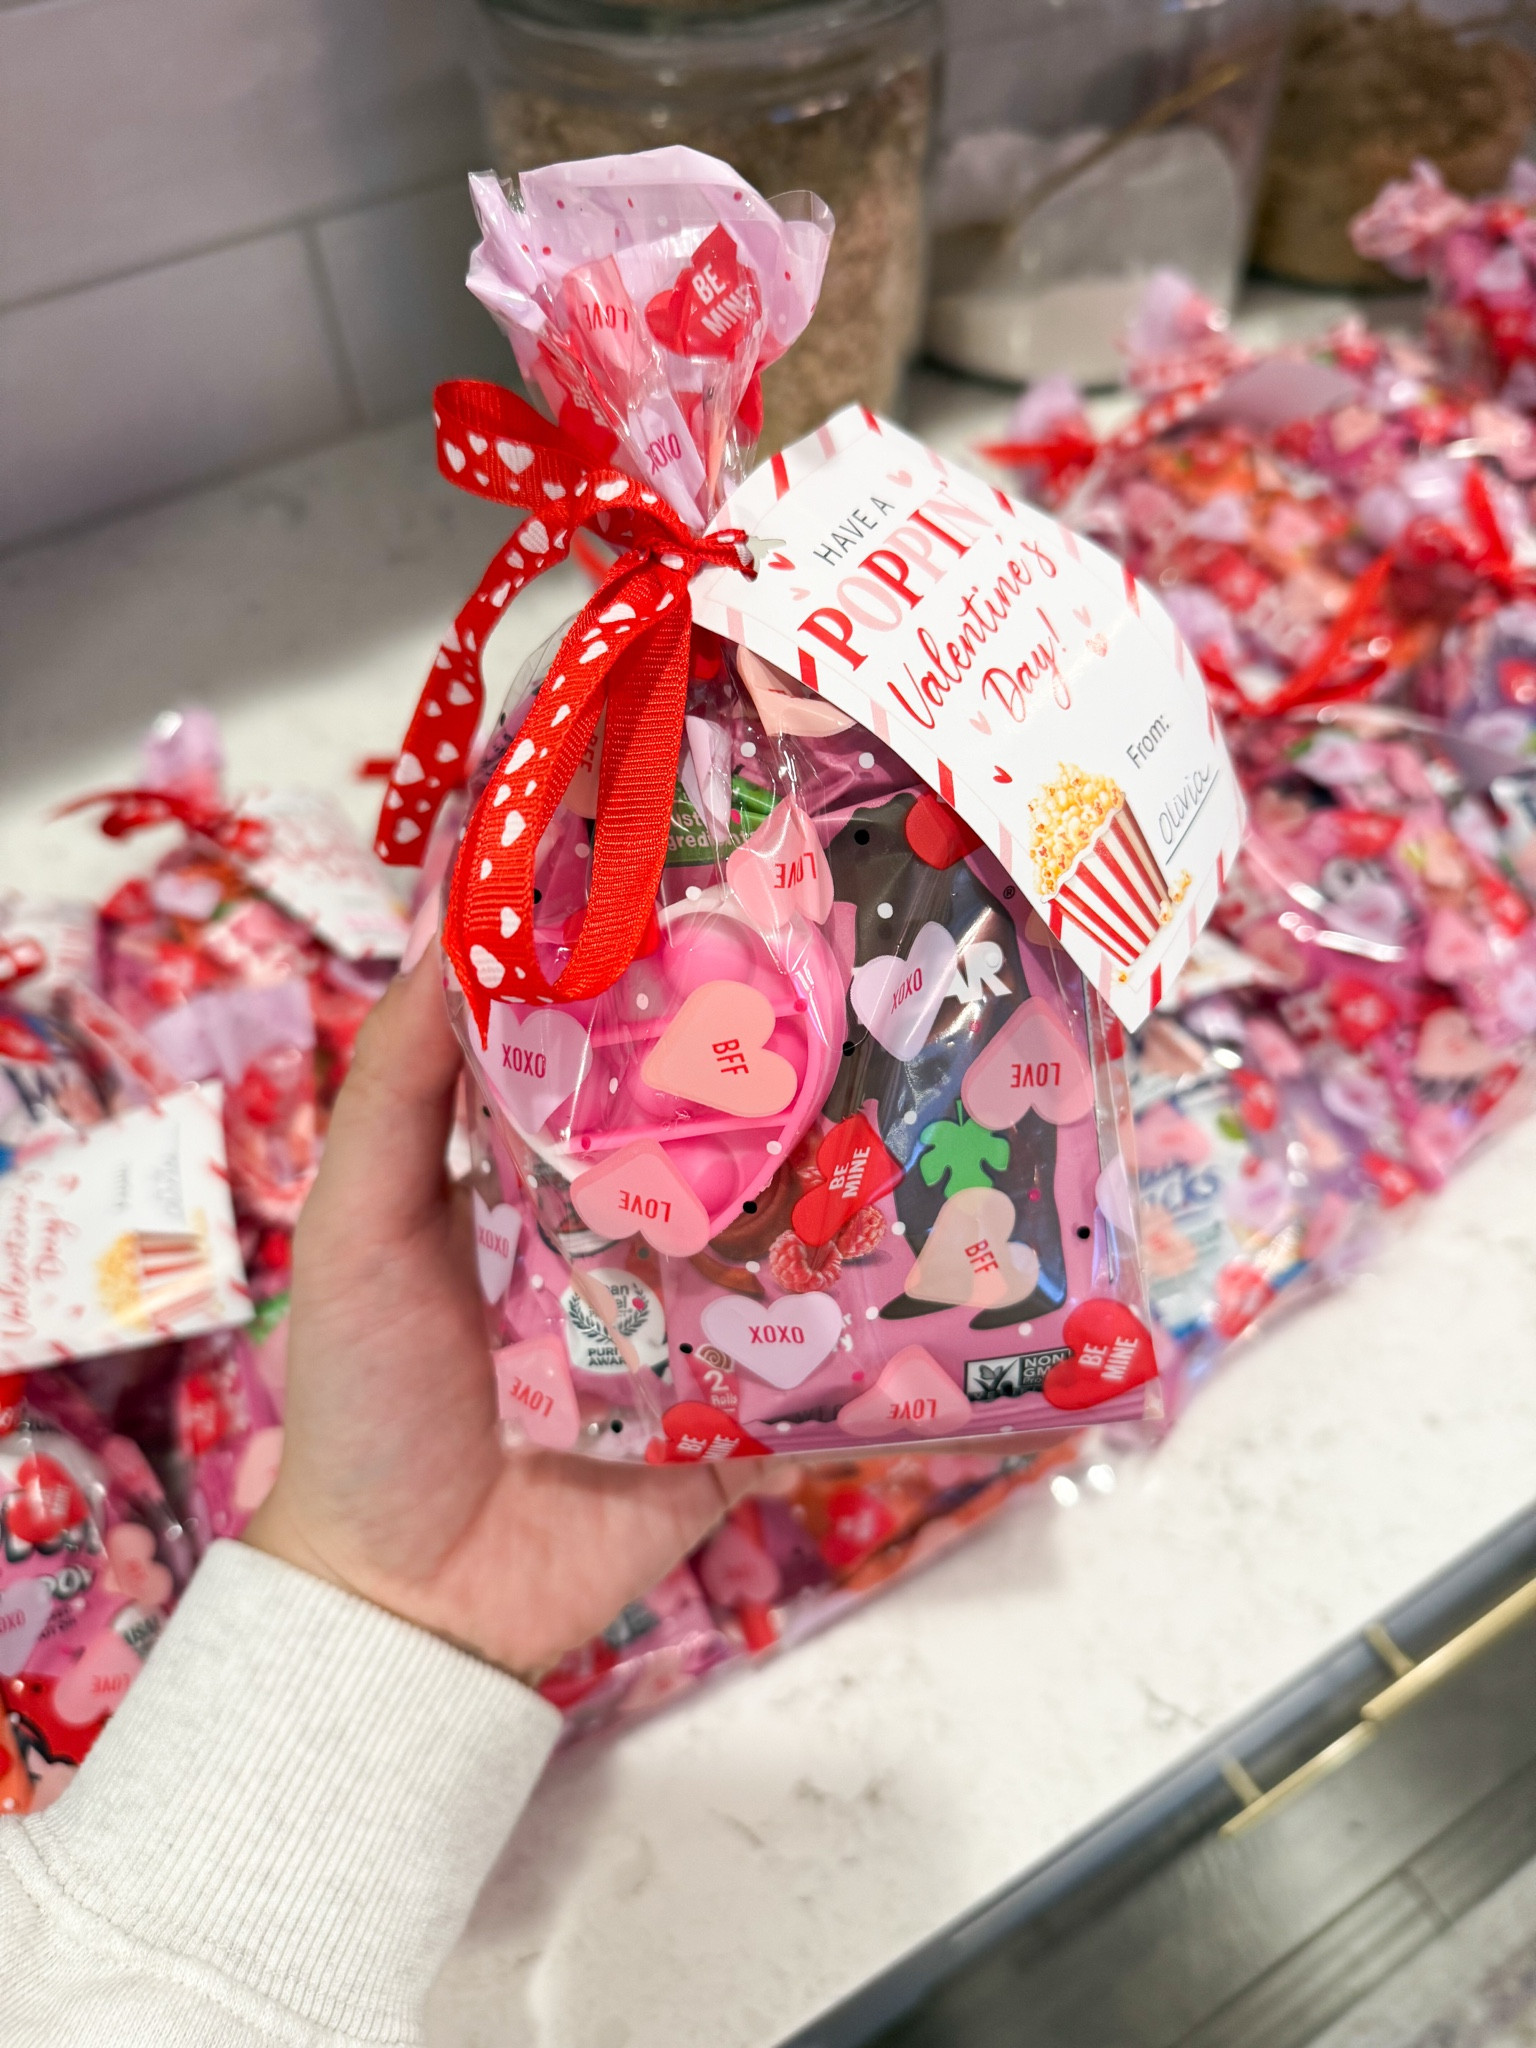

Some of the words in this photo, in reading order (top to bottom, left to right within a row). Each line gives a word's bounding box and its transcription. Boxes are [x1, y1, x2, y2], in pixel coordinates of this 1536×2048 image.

[692, 263, 727, 305] BE
[645, 433, 682, 476] XOXO
[813, 504, 878, 566] HAVE
[869, 496, 896, 519] A
[887, 534, 1057, 730] Valentine's
[980, 606, 1072, 723] Day!
[1125, 712, 1171, 771] From:
[890, 968, 923, 1015] XOXO
[502, 1044, 547, 1080] XOXO
[712, 1038, 750, 1076] BFF
[1010, 1062, 1061, 1089] LOVE
[829, 1162, 849, 1191] BE
[841, 1147, 871, 1199] MINE
[618, 1190, 672, 1223] LOVE
[477, 1225, 509, 1259] XOXO
[964, 1239, 999, 1275] BFF
[747, 1325, 805, 1344] XOXO
[1023, 1366, 1052, 1378] GM
[1077, 1342, 1109, 1369] BE
[1101, 1336, 1139, 1381] MINE
[511, 1376, 556, 1418] LOVE
[703, 1370, 730, 1392] 2
[886, 1398, 937, 1420] LOVE
